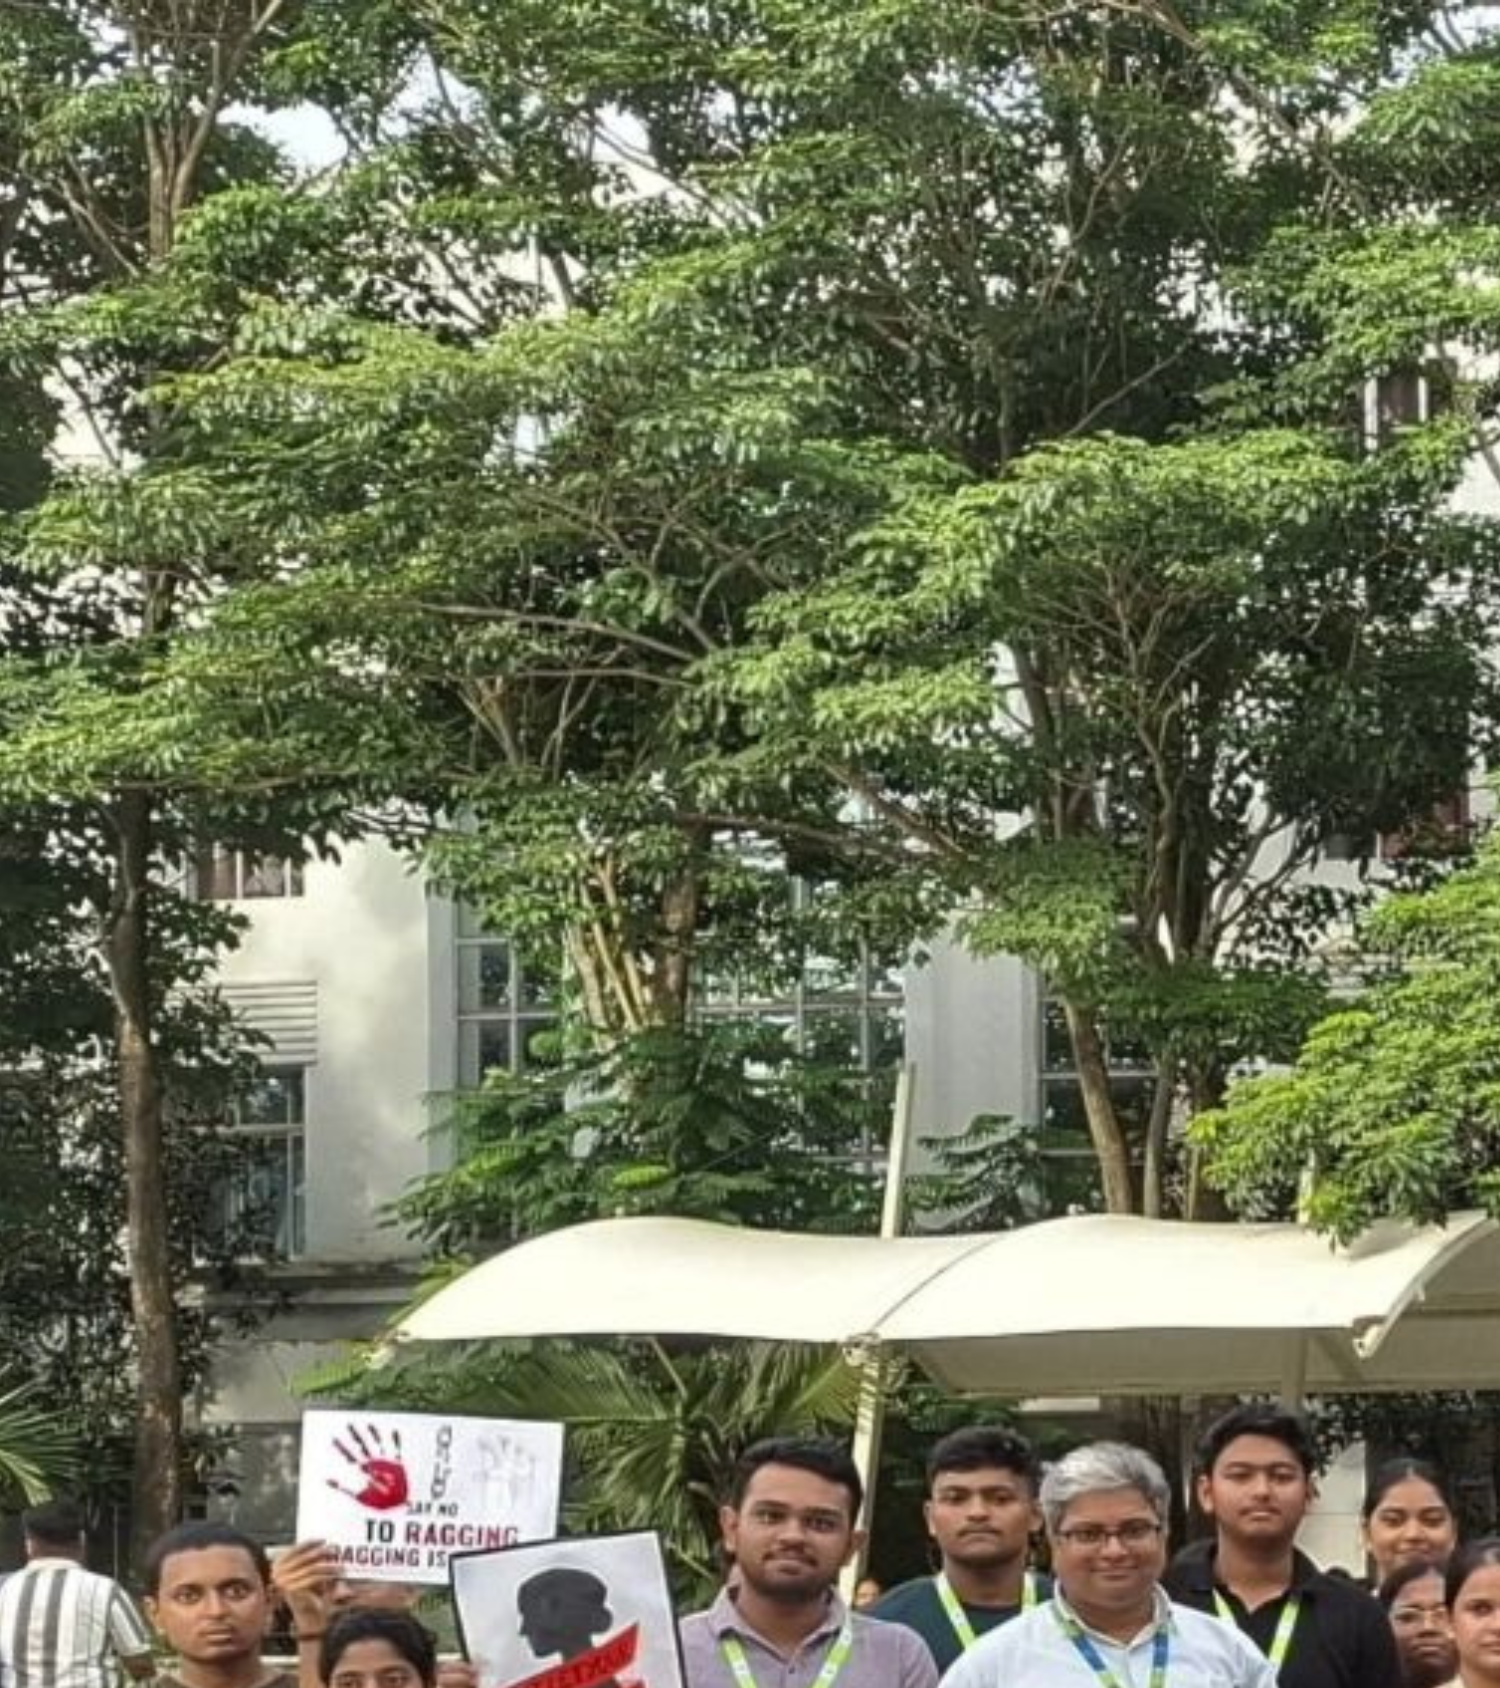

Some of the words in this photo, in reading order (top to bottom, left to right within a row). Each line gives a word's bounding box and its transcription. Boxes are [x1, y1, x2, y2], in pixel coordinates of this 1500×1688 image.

[437, 1503, 458, 1517] NO
[365, 1519, 395, 1544] TO
[404, 1523, 519, 1547] RAGGING
[427, 1550, 447, 1567] IS
